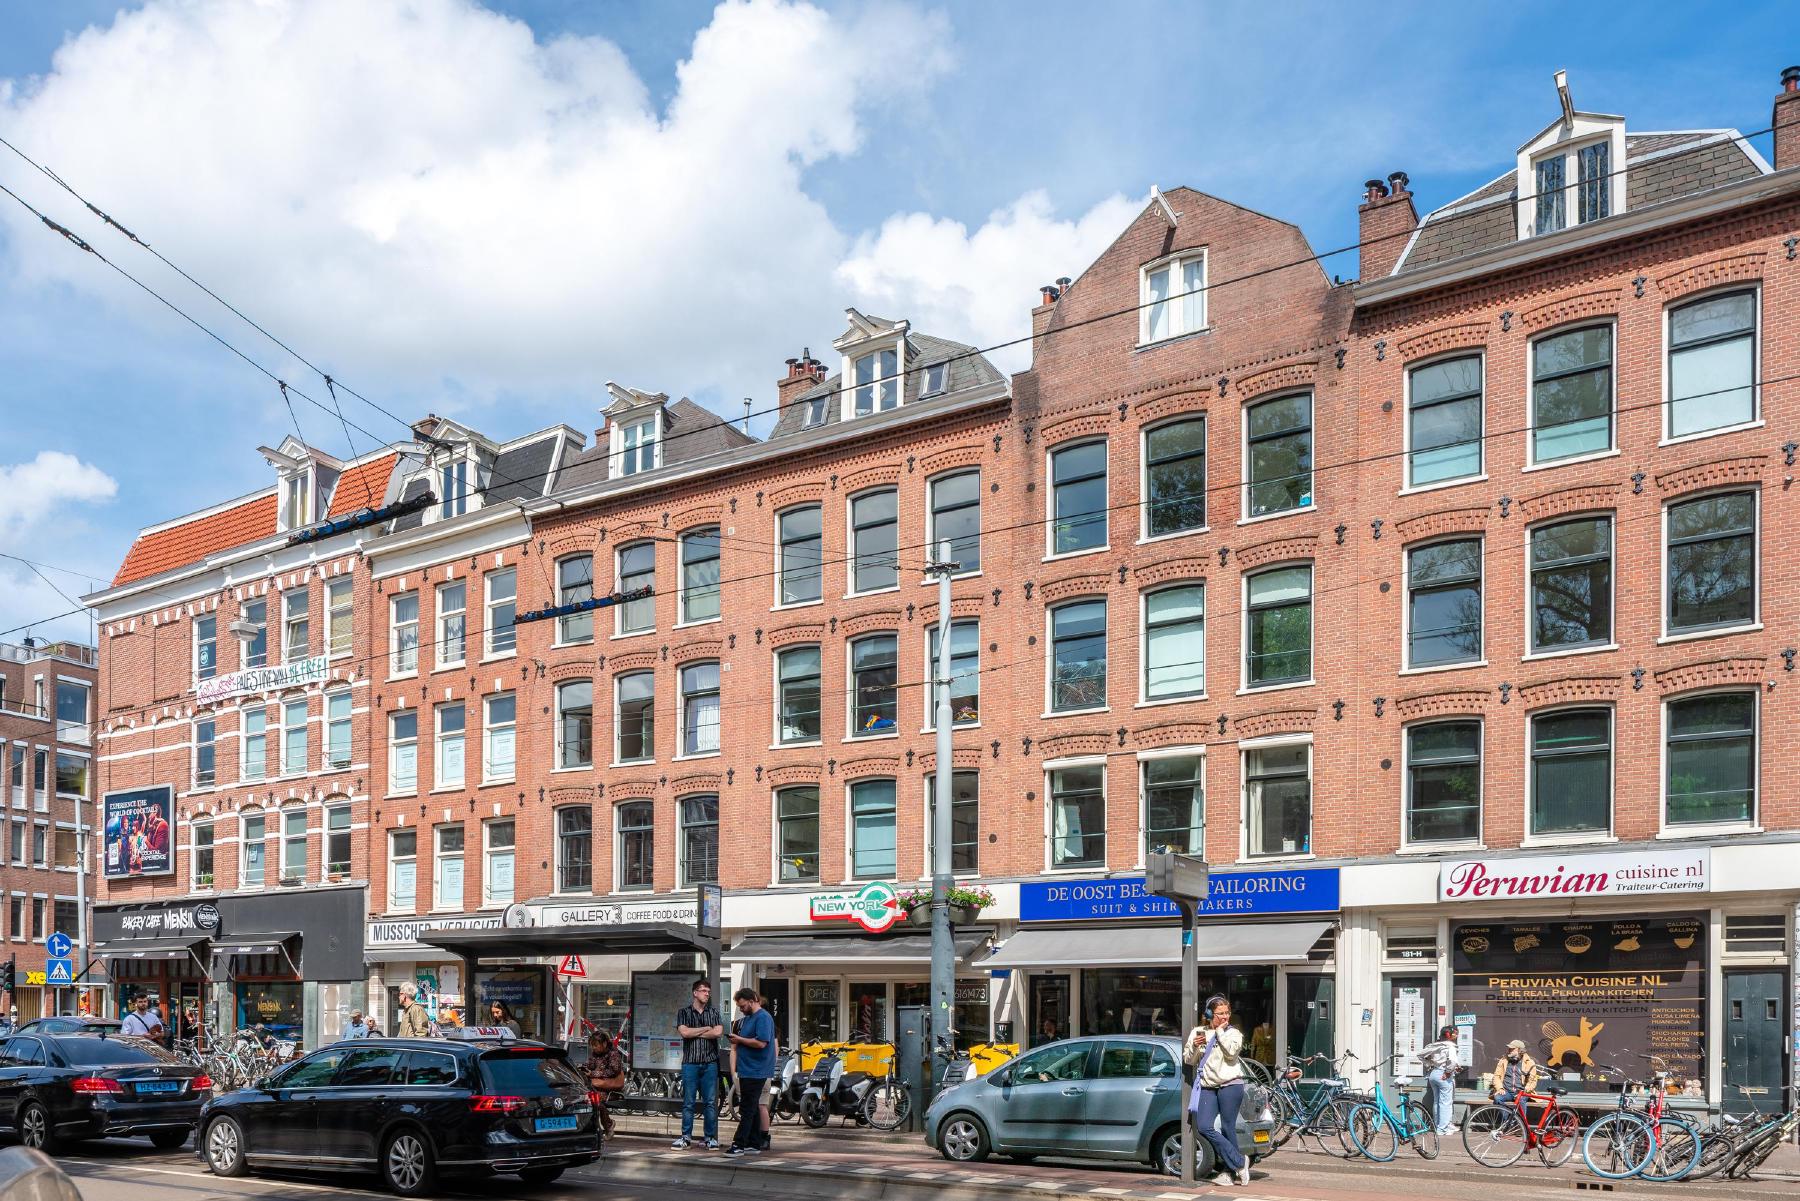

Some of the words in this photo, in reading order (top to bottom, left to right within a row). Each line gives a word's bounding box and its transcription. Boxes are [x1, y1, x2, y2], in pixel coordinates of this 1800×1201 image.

[236, 669, 272, 691] PALESTINE
[109, 801, 136, 810] EXPERIENCE
[136, 799, 148, 807] THE
[109, 810, 126, 818] WORLD
[126, 808, 133, 816] OF
[132, 805, 159, 816] COCKTAILS
[1446, 862, 1609, 898] Peruvian
[1615, 864, 1679, 880] cuisine
[1685, 860, 1704, 877] nl
[1047, 888, 1069, 902] DE
[1072, 885, 1115, 900] OOST
[1207, 876, 1306, 895] TAILORING
[1615, 880, 1704, 892] Traiteur-Catering
[817, 902, 846, 912] NEW
[848, 900, 882, 912] YORK
[1091, 903, 1124, 914] SUIT
[1129, 903, 1137, 913] &
[1143, 901, 1177, 912] SHIR
[561, 909, 611, 923] GALLERY
[626, 911, 651, 920] COFFEE
[652, 909, 672, 919] FOOD
[673, 909, 679, 919] &
[679, 908, 699, 919] DRIN
[122, 916, 145, 930] BAKERY
[1401, 950, 1423, 958] 181-H
[1488, 977, 1567, 989] PERUVIAN
[1570, 975, 1638, 988] CUISINE
[1641, 975, 1669, 987] NL
[808, 988, 838, 999] OPEN
[1500, 989, 1521, 997] THE
[1523, 989, 1551, 997] REAL
[1551, 988, 1605, 997] PERUVIAN
[1607, 988, 1654, 996] KITCHEN
[1547, 1005, 1601, 1014] PERUVIAN
[1599, 1005, 1649, 1013] KITCHEN
